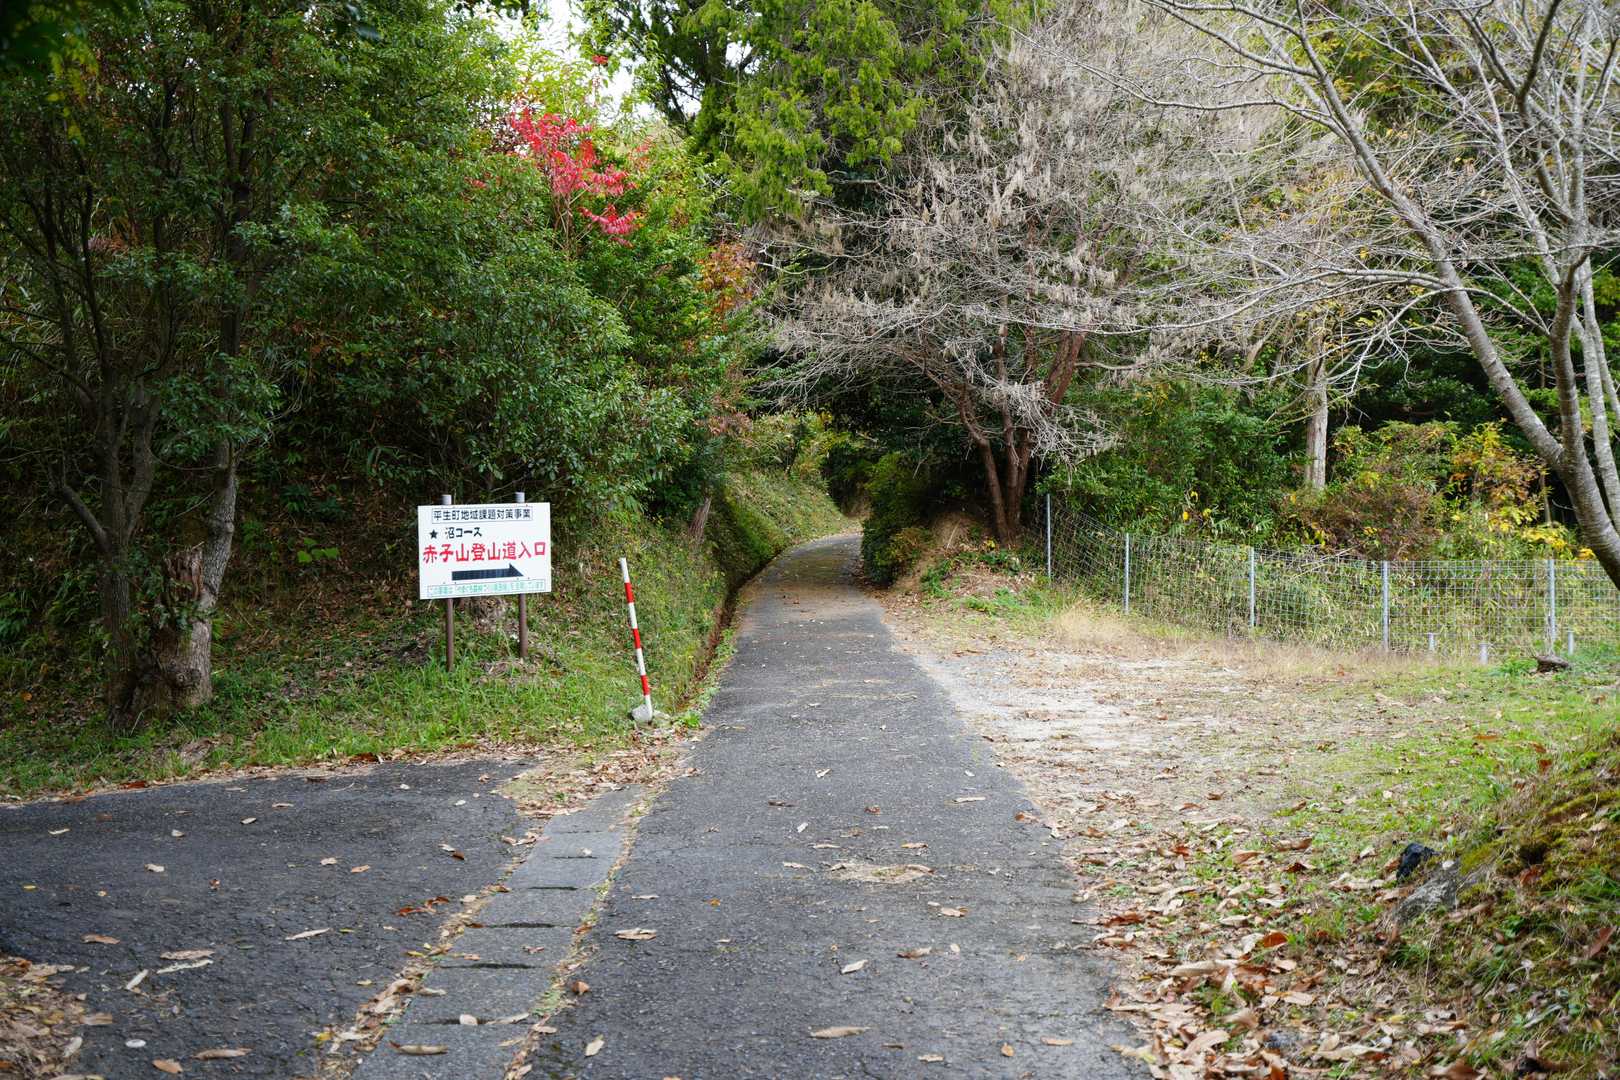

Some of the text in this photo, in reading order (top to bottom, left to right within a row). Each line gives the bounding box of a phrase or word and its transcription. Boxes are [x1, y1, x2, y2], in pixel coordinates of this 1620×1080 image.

[433, 508, 531, 521] 平生町地域課題対策事業
[445, 526, 482, 539] 沼コース
[422, 541, 546, 564] 赤子山登山道入口
